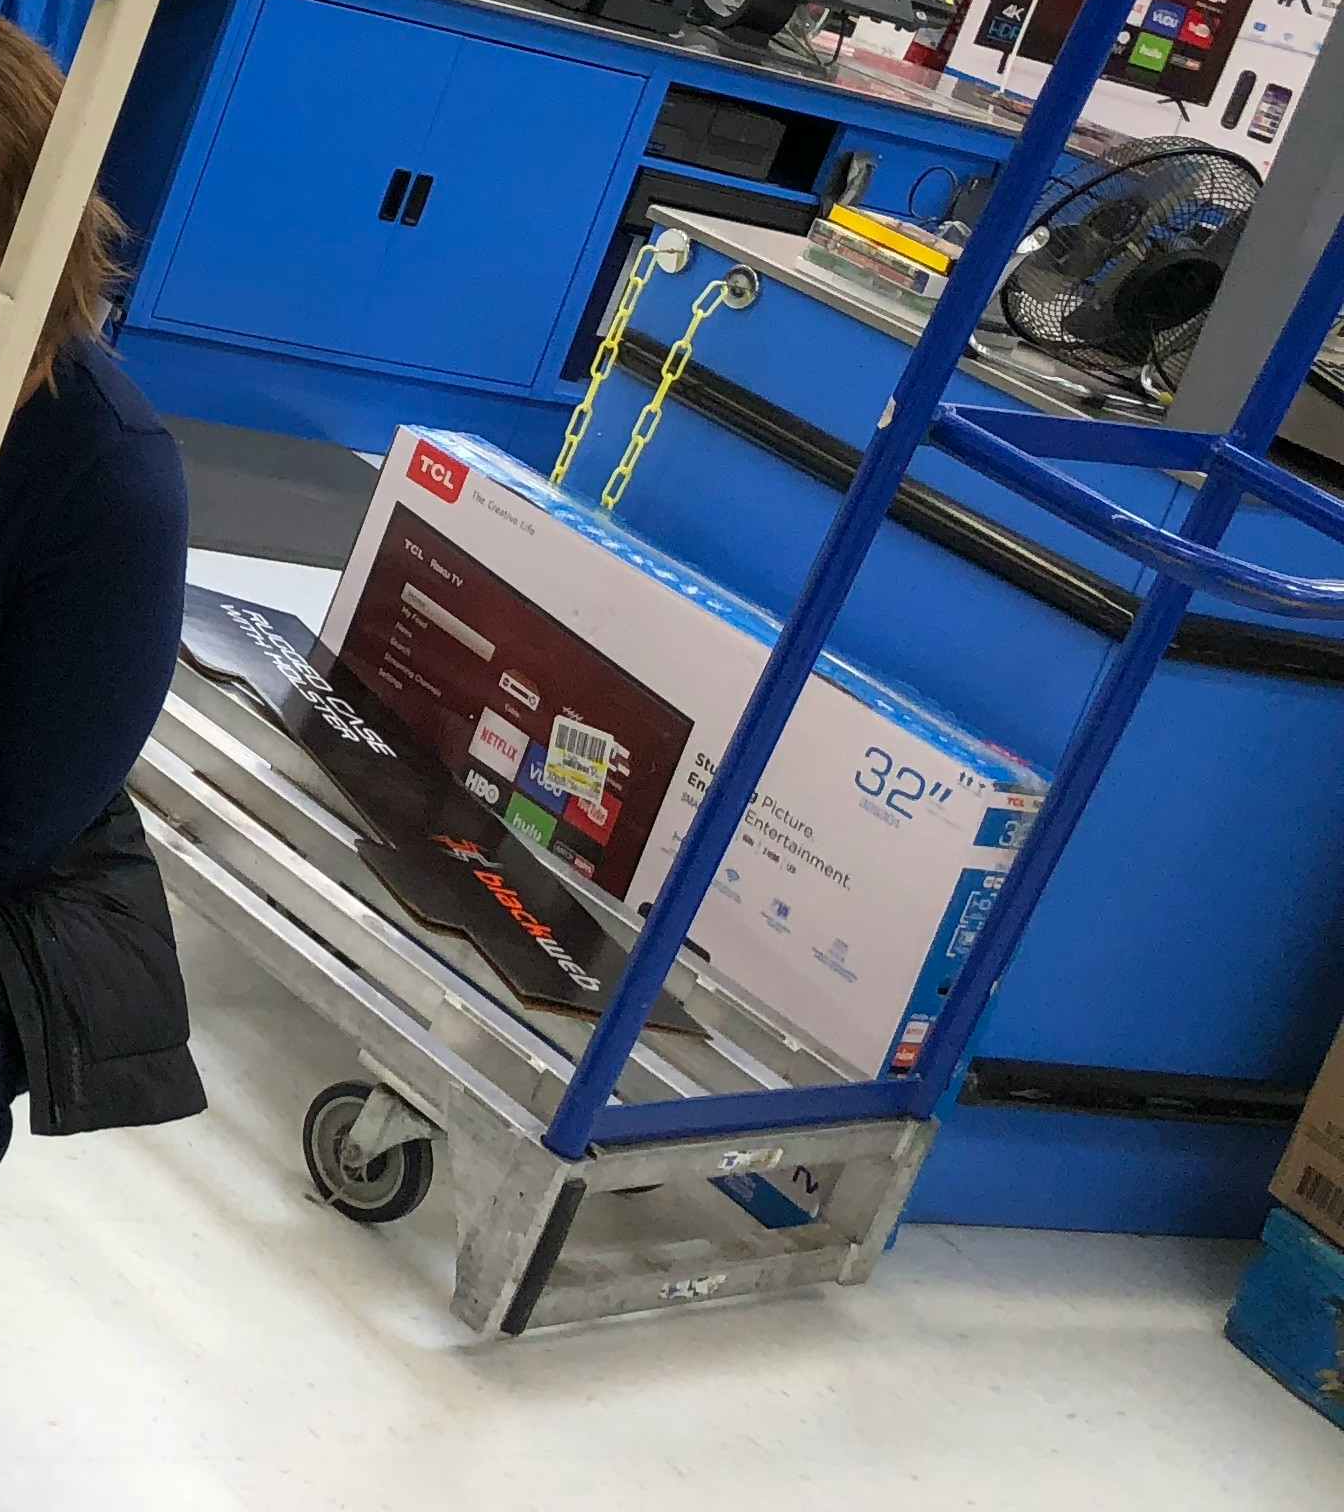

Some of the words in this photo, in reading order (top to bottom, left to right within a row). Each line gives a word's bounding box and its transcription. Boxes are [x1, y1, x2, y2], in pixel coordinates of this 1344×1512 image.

[1002, 3, 1025, 22] 4K
[420, 454, 454, 490] TCL
[487, 500, 519, 525] Creative
[519, 519, 536, 536] Life
[403, 538, 424, 561] TCL
[219, 603, 273, 649] WITH
[264, 650, 361, 743] HOLSTER
[241, 607, 334, 693] RUGGED
[326, 695, 399, 759] CASE
[480, 726, 519, 762] NETFLIX
[465, 768, 500, 805] HBO
[512, 812, 543, 842] hulu
[761, 794, 816, 840] Picture.
[743, 809, 852, 891] Entertainment.
[474, 870, 602, 992] blackweb
